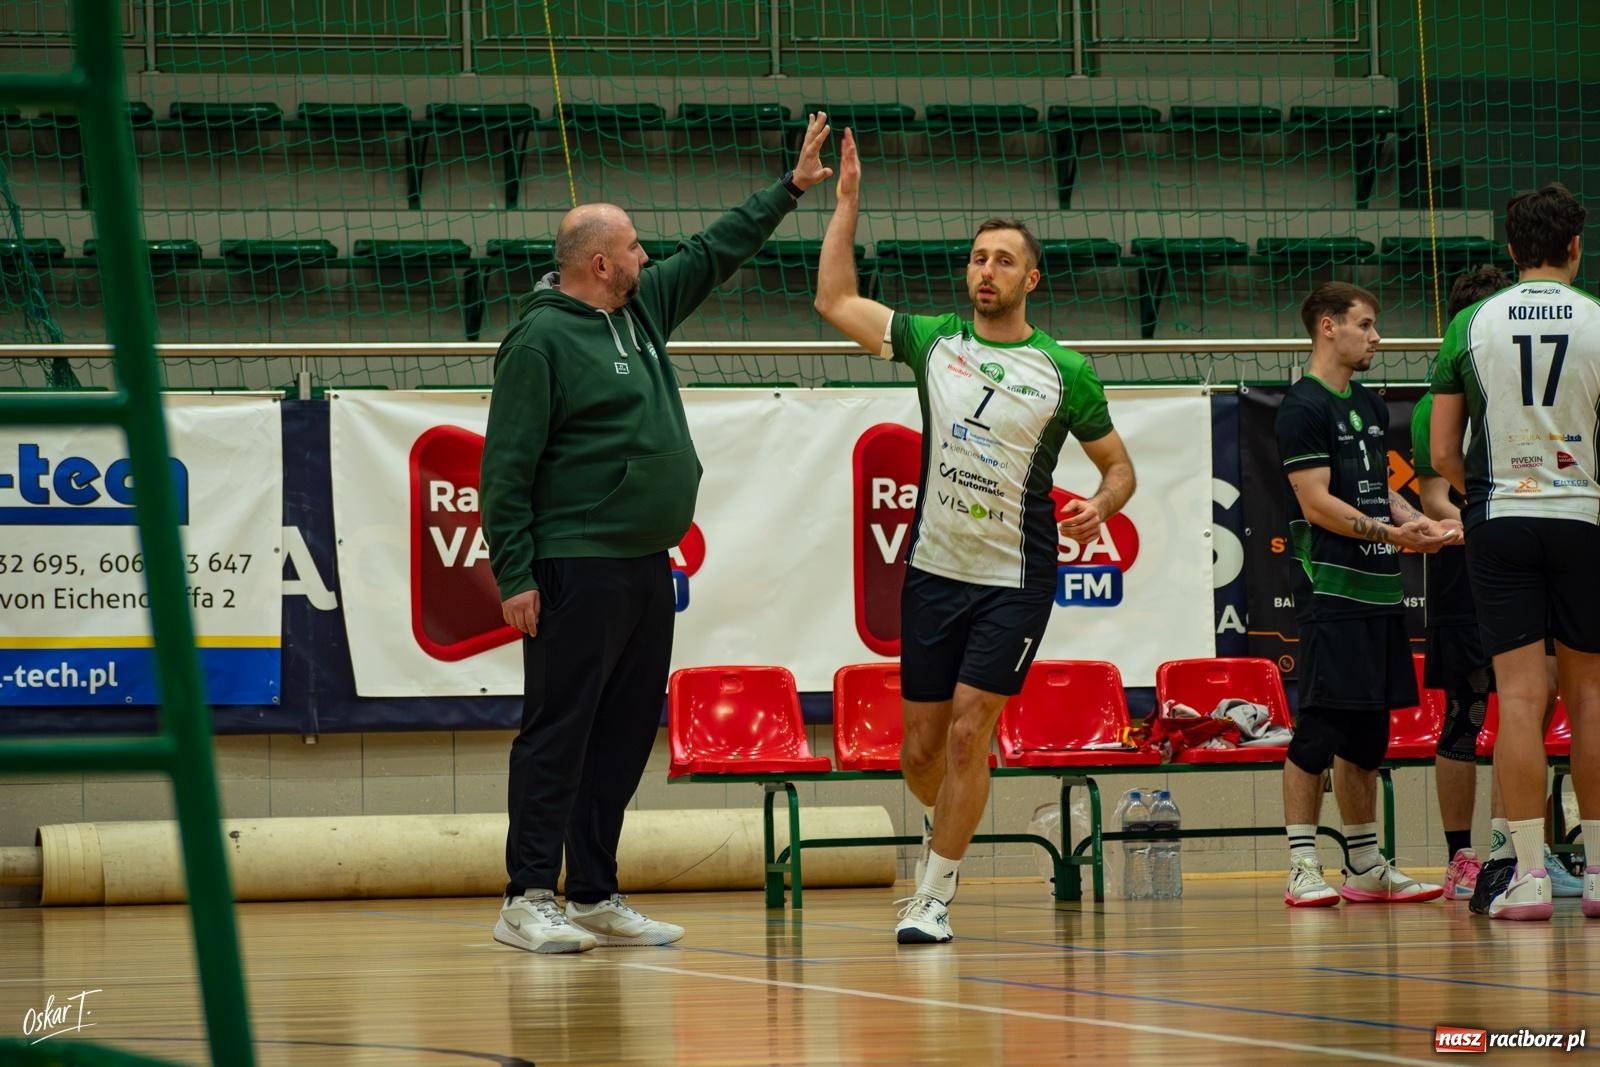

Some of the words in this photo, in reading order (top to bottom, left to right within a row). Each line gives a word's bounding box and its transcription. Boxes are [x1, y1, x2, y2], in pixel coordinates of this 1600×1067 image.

[1508, 305, 1573, 320] KOZIELEC
[1512, 334, 1569, 407] 17
[1511, 456, 1543, 464] PIVEXIN
[0, 443, 189, 512] -tec
[958, 479, 1005, 498] automatic
[959, 470, 999, 488] CONCEPT
[872, 477, 918, 510] Ra
[938, 491, 1004, 518] VISON
[33, 554, 85, 576] 695,
[208, 553, 252, 574] 647
[1064, 573, 1112, 600] FM
[0, 590, 45, 609] von
[223, 590, 236, 609] 2
[1273, 596, 1295, 609] BA
[0, 661, 118, 694] -tech.pl
